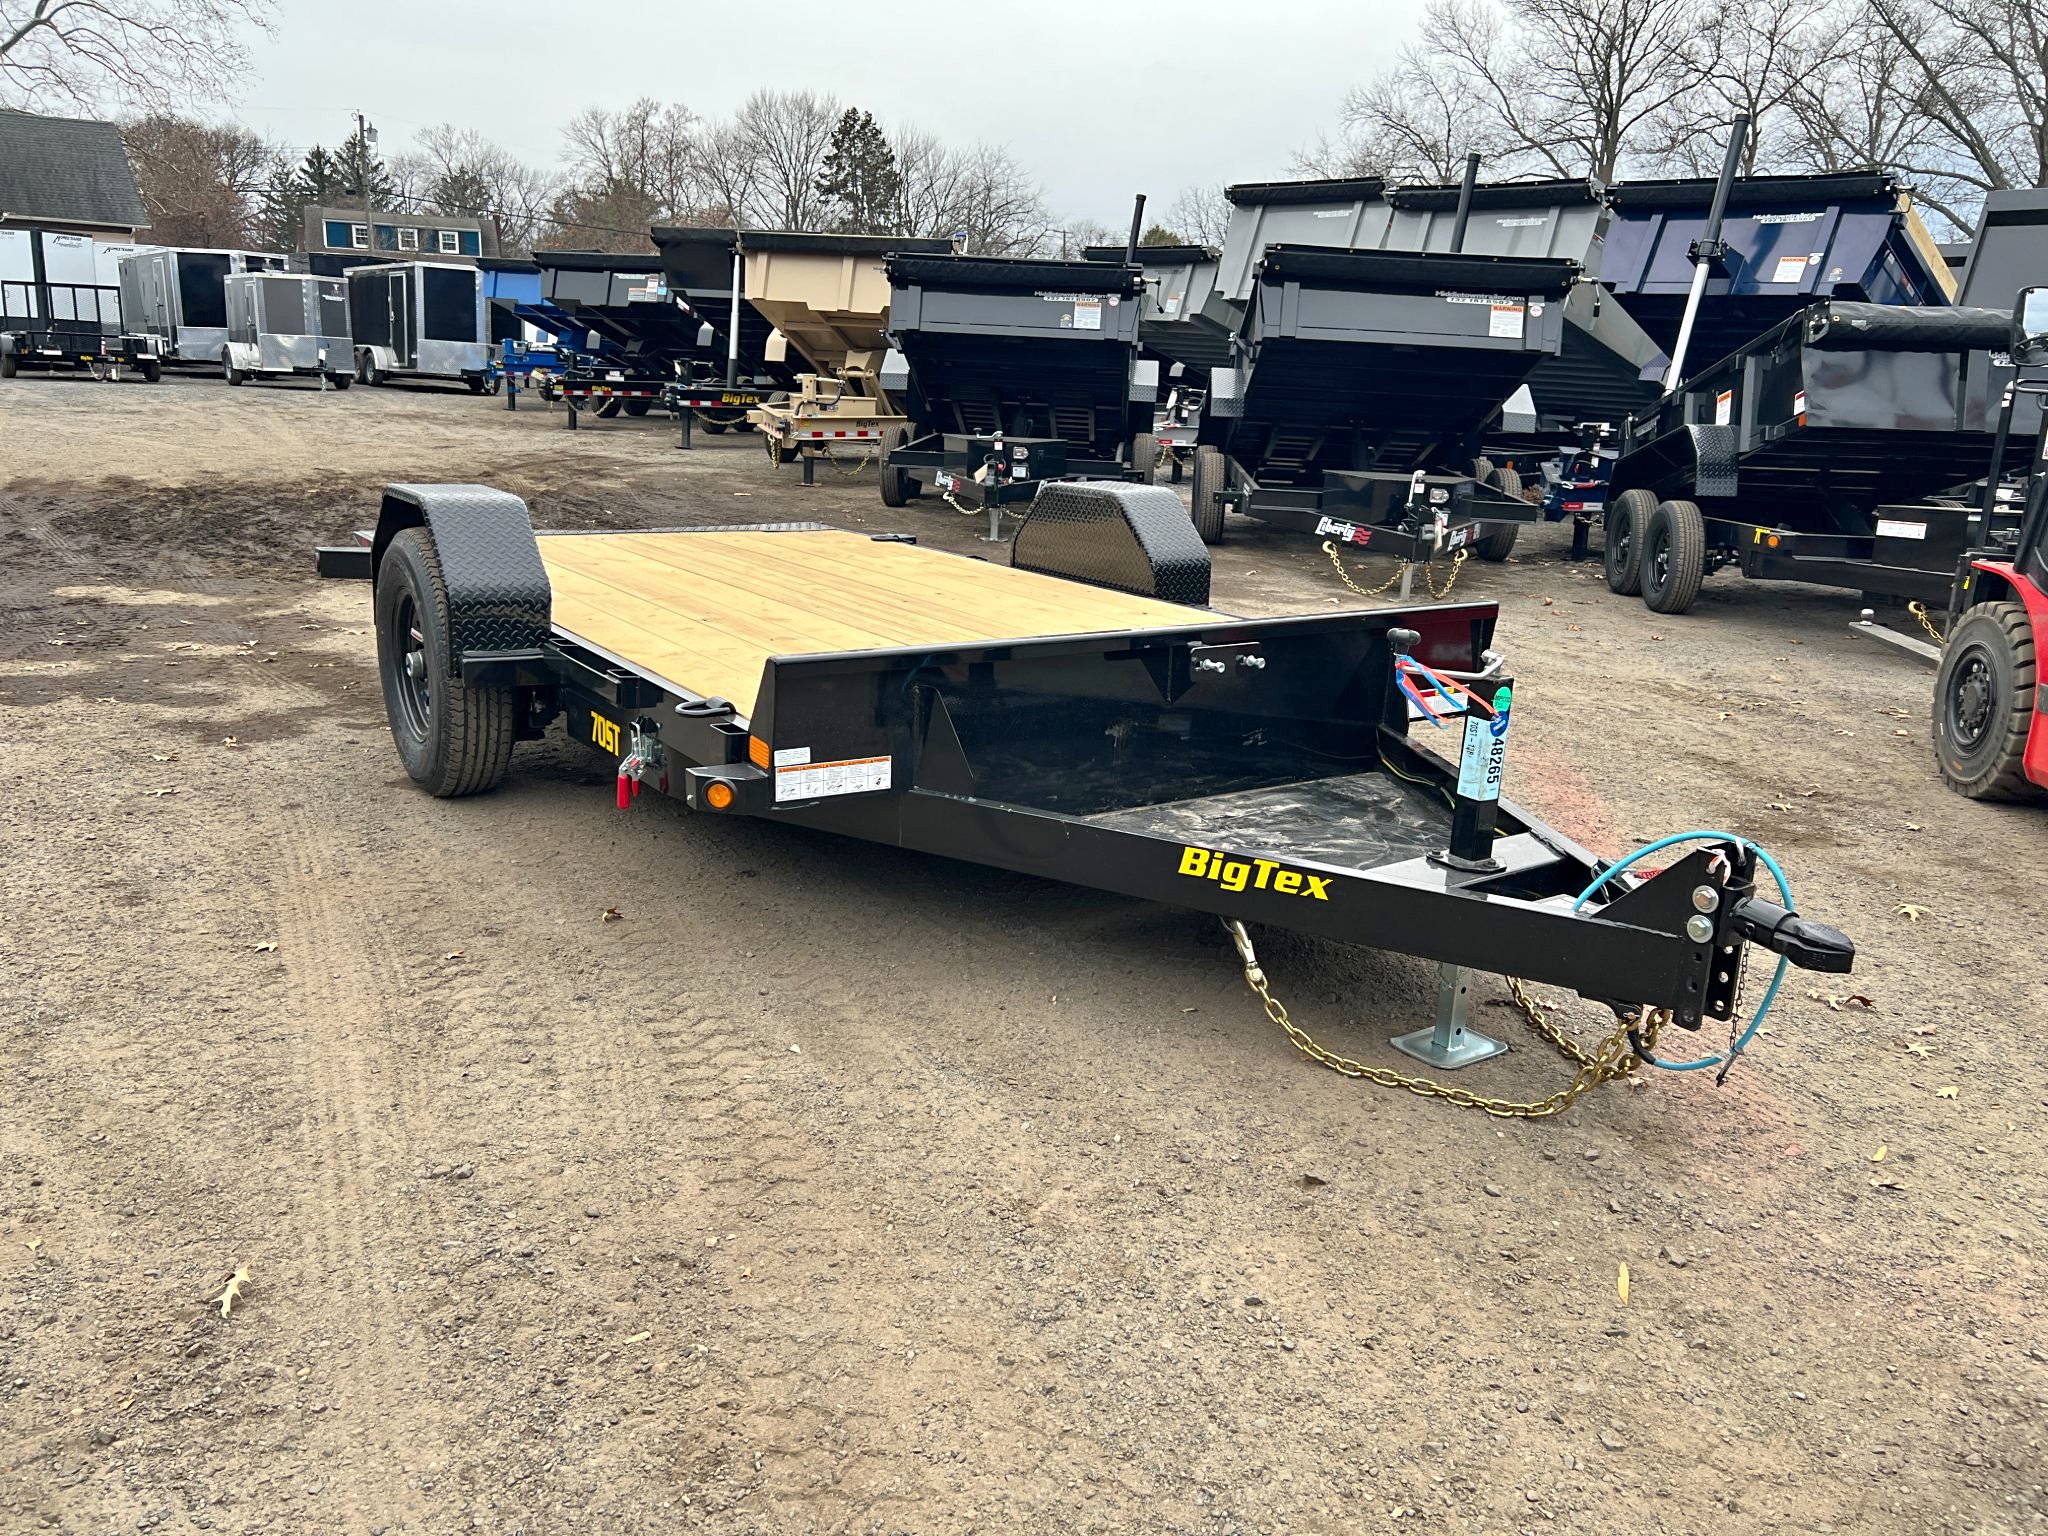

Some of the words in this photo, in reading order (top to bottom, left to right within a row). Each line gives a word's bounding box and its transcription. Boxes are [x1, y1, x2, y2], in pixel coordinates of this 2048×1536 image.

[1493, 305, 1522, 313] WARNING
[722, 393, 760, 404] BigTex
[856, 420, 879, 428] BigTex
[1315, 516, 1357, 541] Liberty
[591, 710, 620, 757] 70ST
[1487, 738, 1505, 784] 48265
[1178, 846, 1333, 901] BigTex
